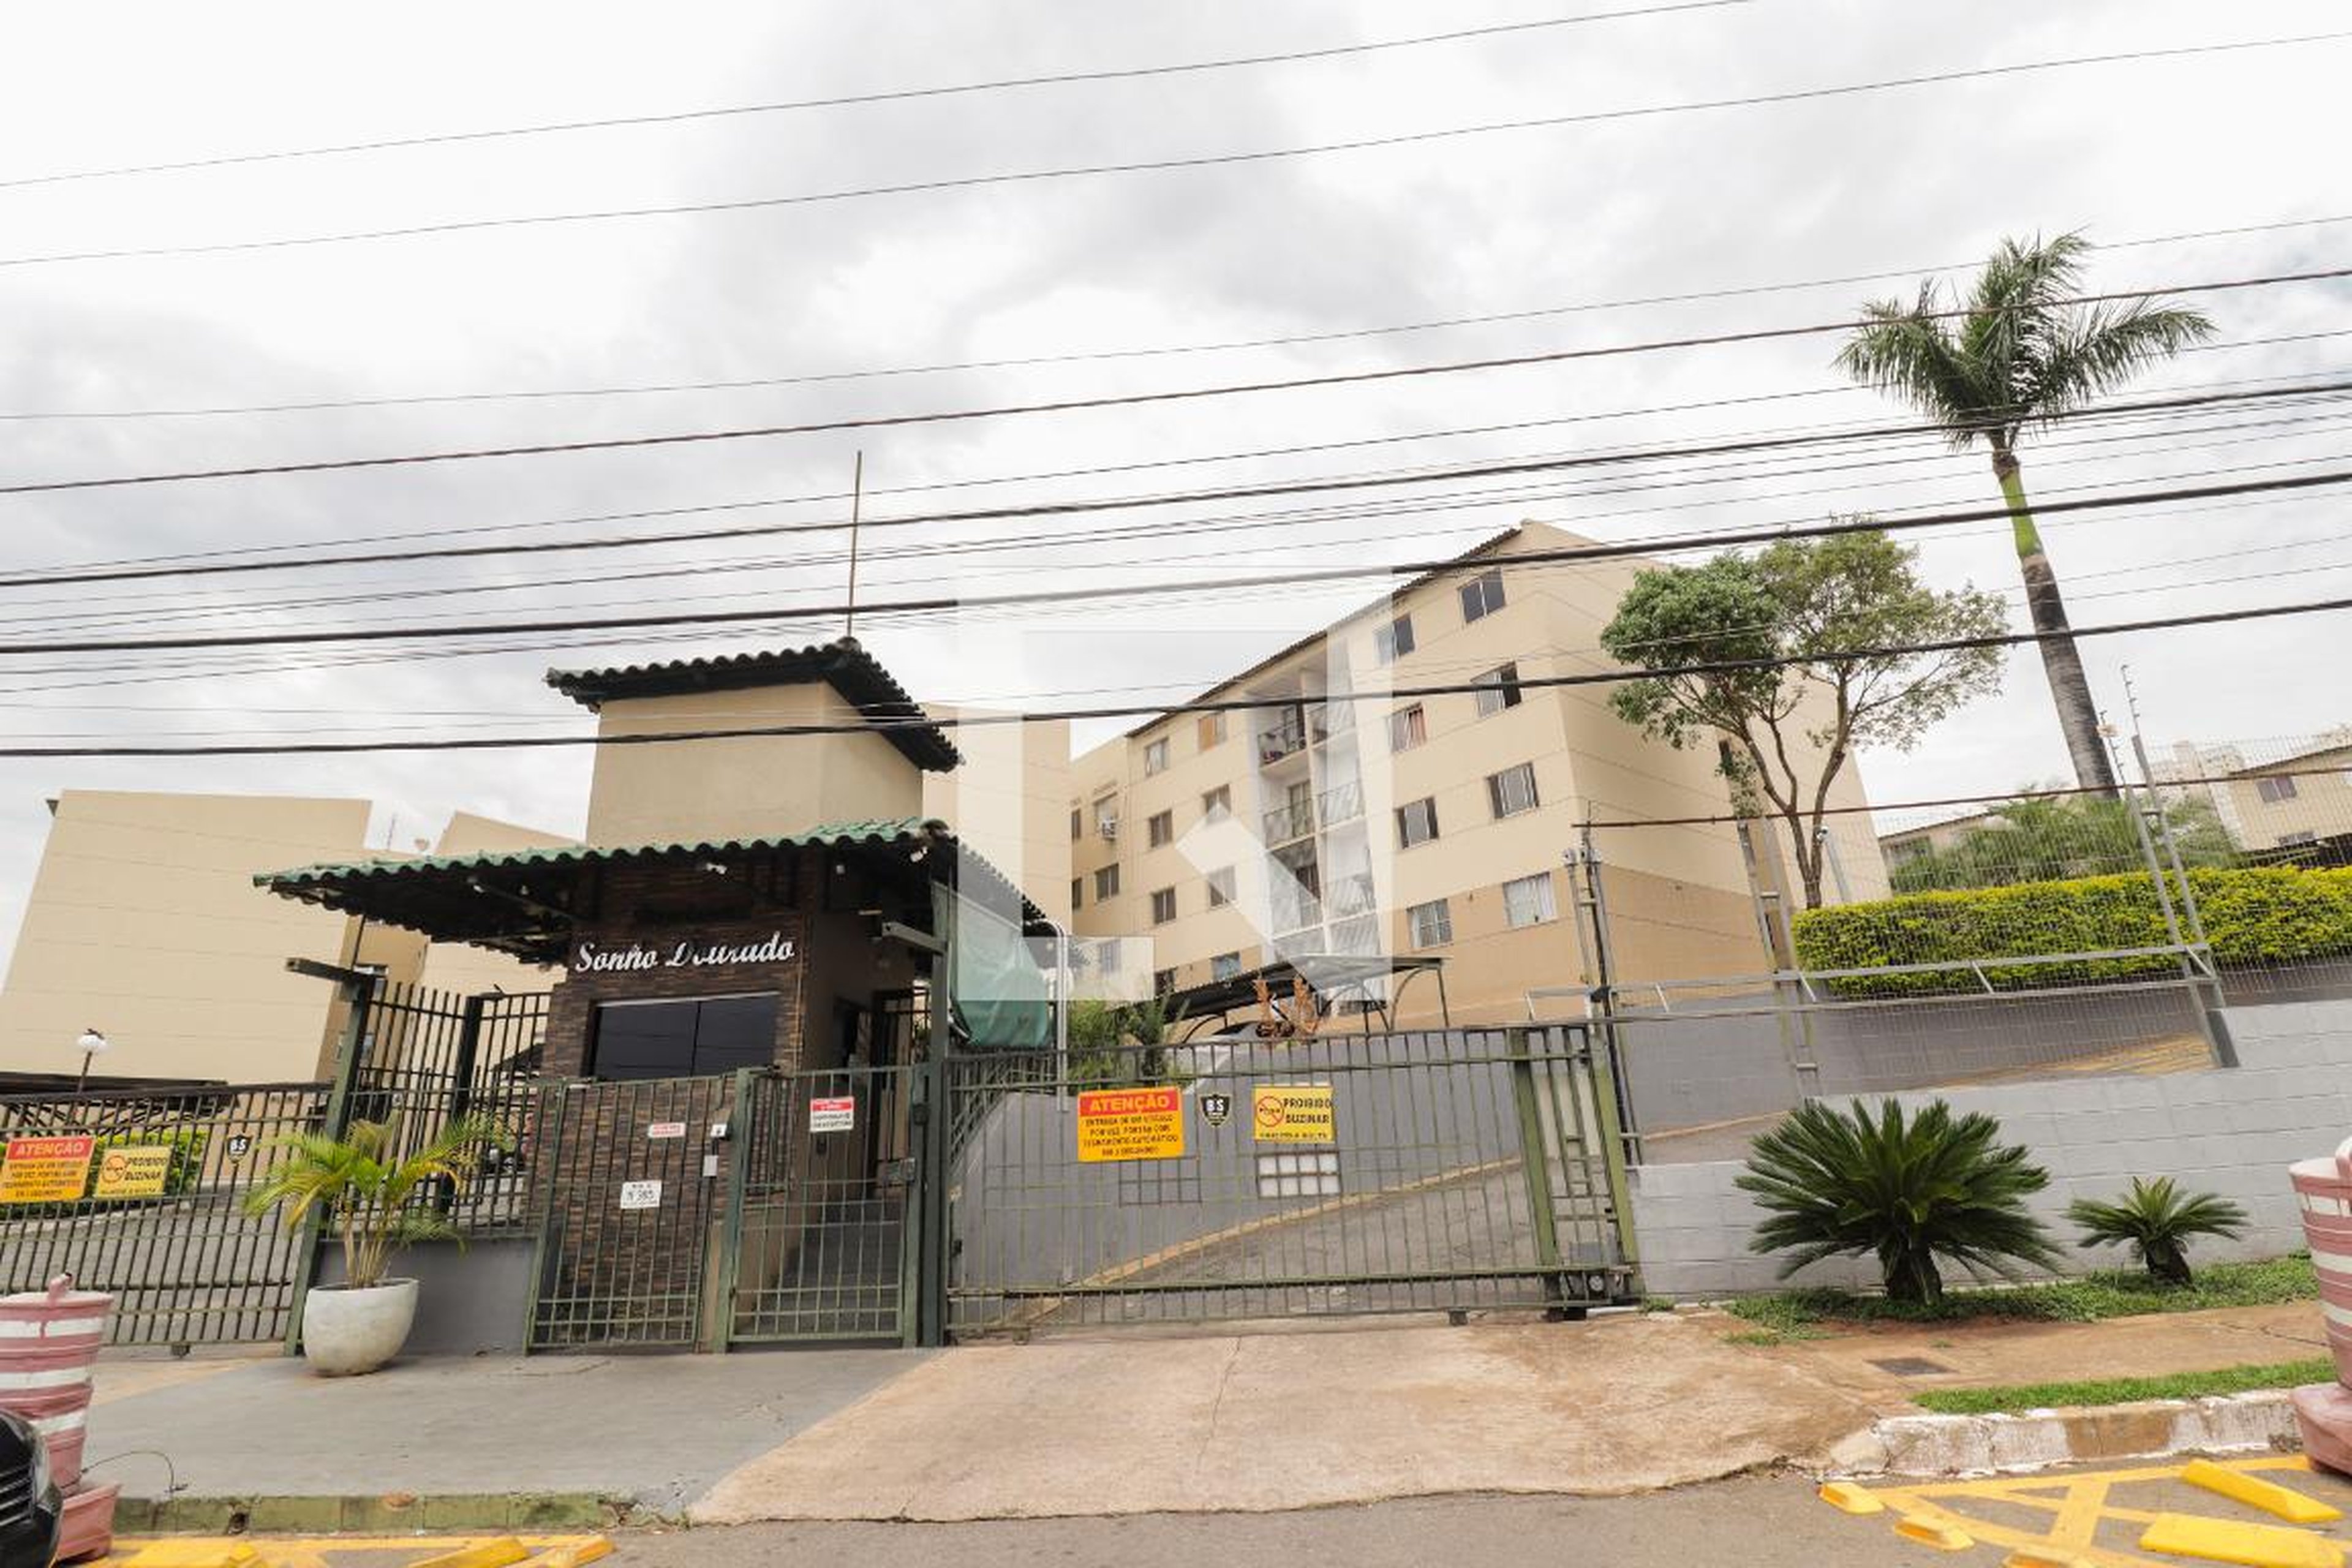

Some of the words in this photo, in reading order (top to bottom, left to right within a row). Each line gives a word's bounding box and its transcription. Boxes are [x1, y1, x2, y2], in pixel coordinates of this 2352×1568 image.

[575, 943, 659, 973] Sonho
[1090, 1094, 1170, 1114] ATENÇÃO
[1283, 1097, 1333, 1109] PROIBIDO
[1286, 1114, 1330, 1123] BUZINAR
